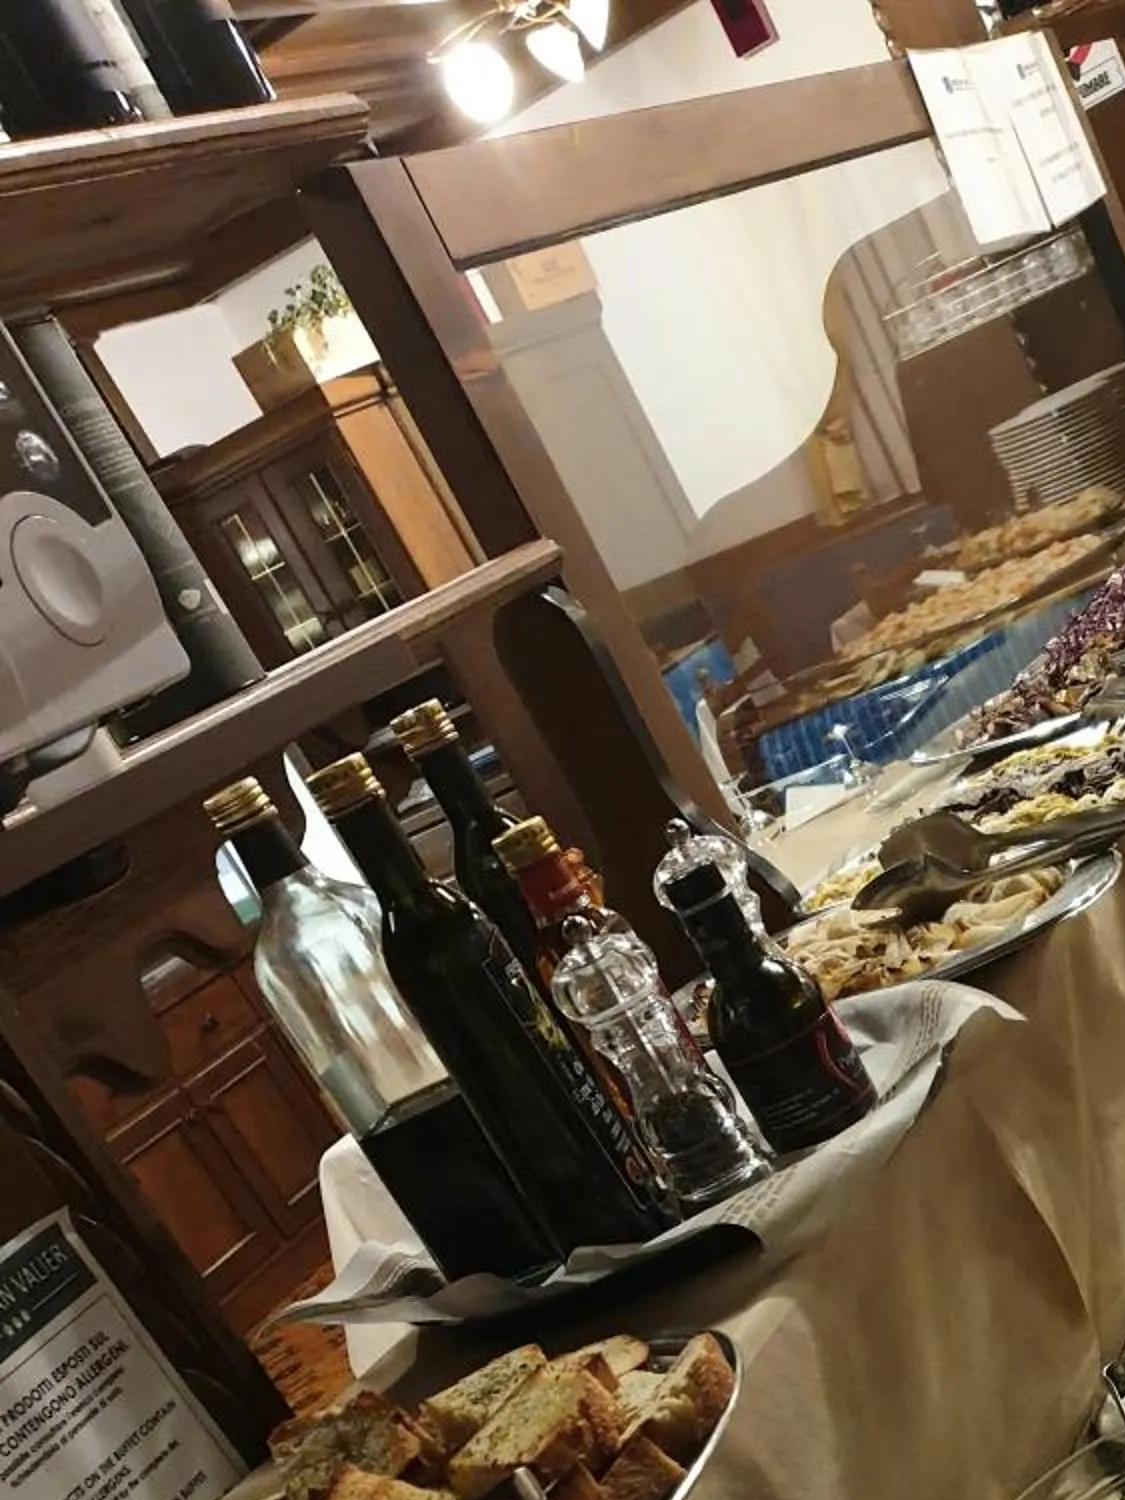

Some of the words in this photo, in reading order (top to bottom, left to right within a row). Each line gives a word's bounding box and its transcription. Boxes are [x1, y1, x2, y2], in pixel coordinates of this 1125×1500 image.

[0, 1377, 54, 1427] PRODOTTI
[51, 1345, 92, 1383] ESPOSTI
[0, 1385, 77, 1457] CONTENGONO
[83, 1472, 101, 1490] ON
